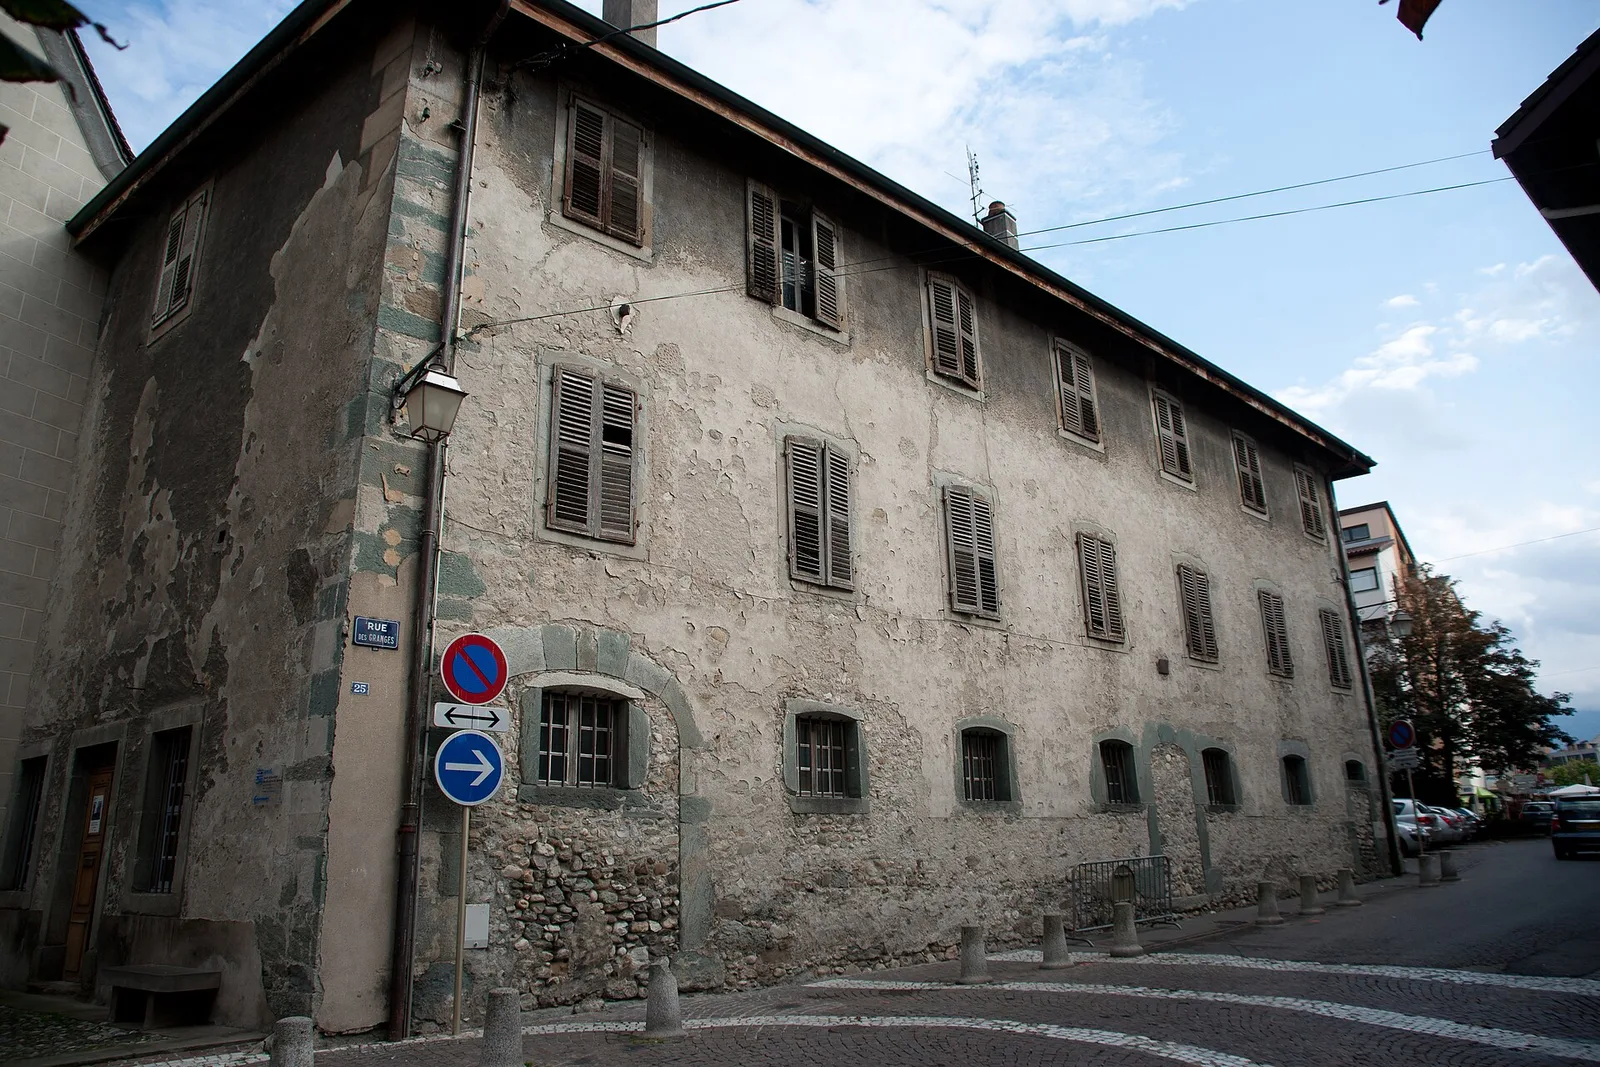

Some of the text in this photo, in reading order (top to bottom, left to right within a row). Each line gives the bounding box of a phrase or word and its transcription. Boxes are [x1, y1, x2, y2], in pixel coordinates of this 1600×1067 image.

[367, 622, 388, 632] RUE
[358, 633, 395, 645] DES GRANGES
[354, 684, 366, 693] 25
